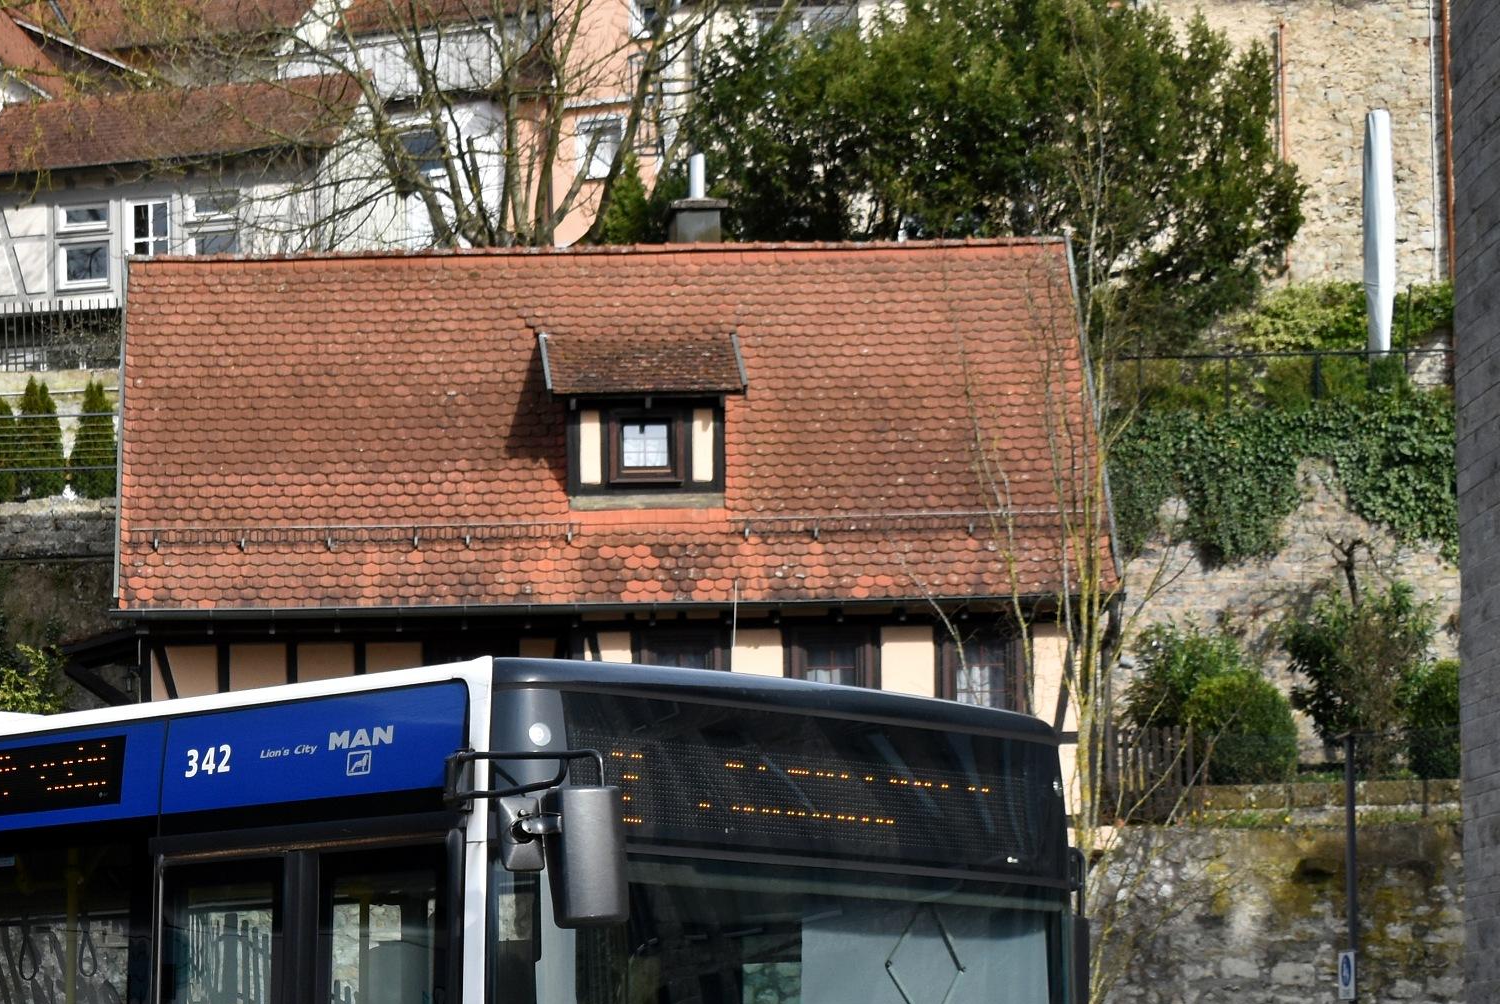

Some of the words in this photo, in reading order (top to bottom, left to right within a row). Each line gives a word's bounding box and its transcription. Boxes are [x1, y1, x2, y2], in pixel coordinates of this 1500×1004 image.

[328, 725, 394, 751] MAN
[184, 744, 232, 778] 342
[260, 747, 290, 759] Lion's
[294, 744, 318, 755] City
